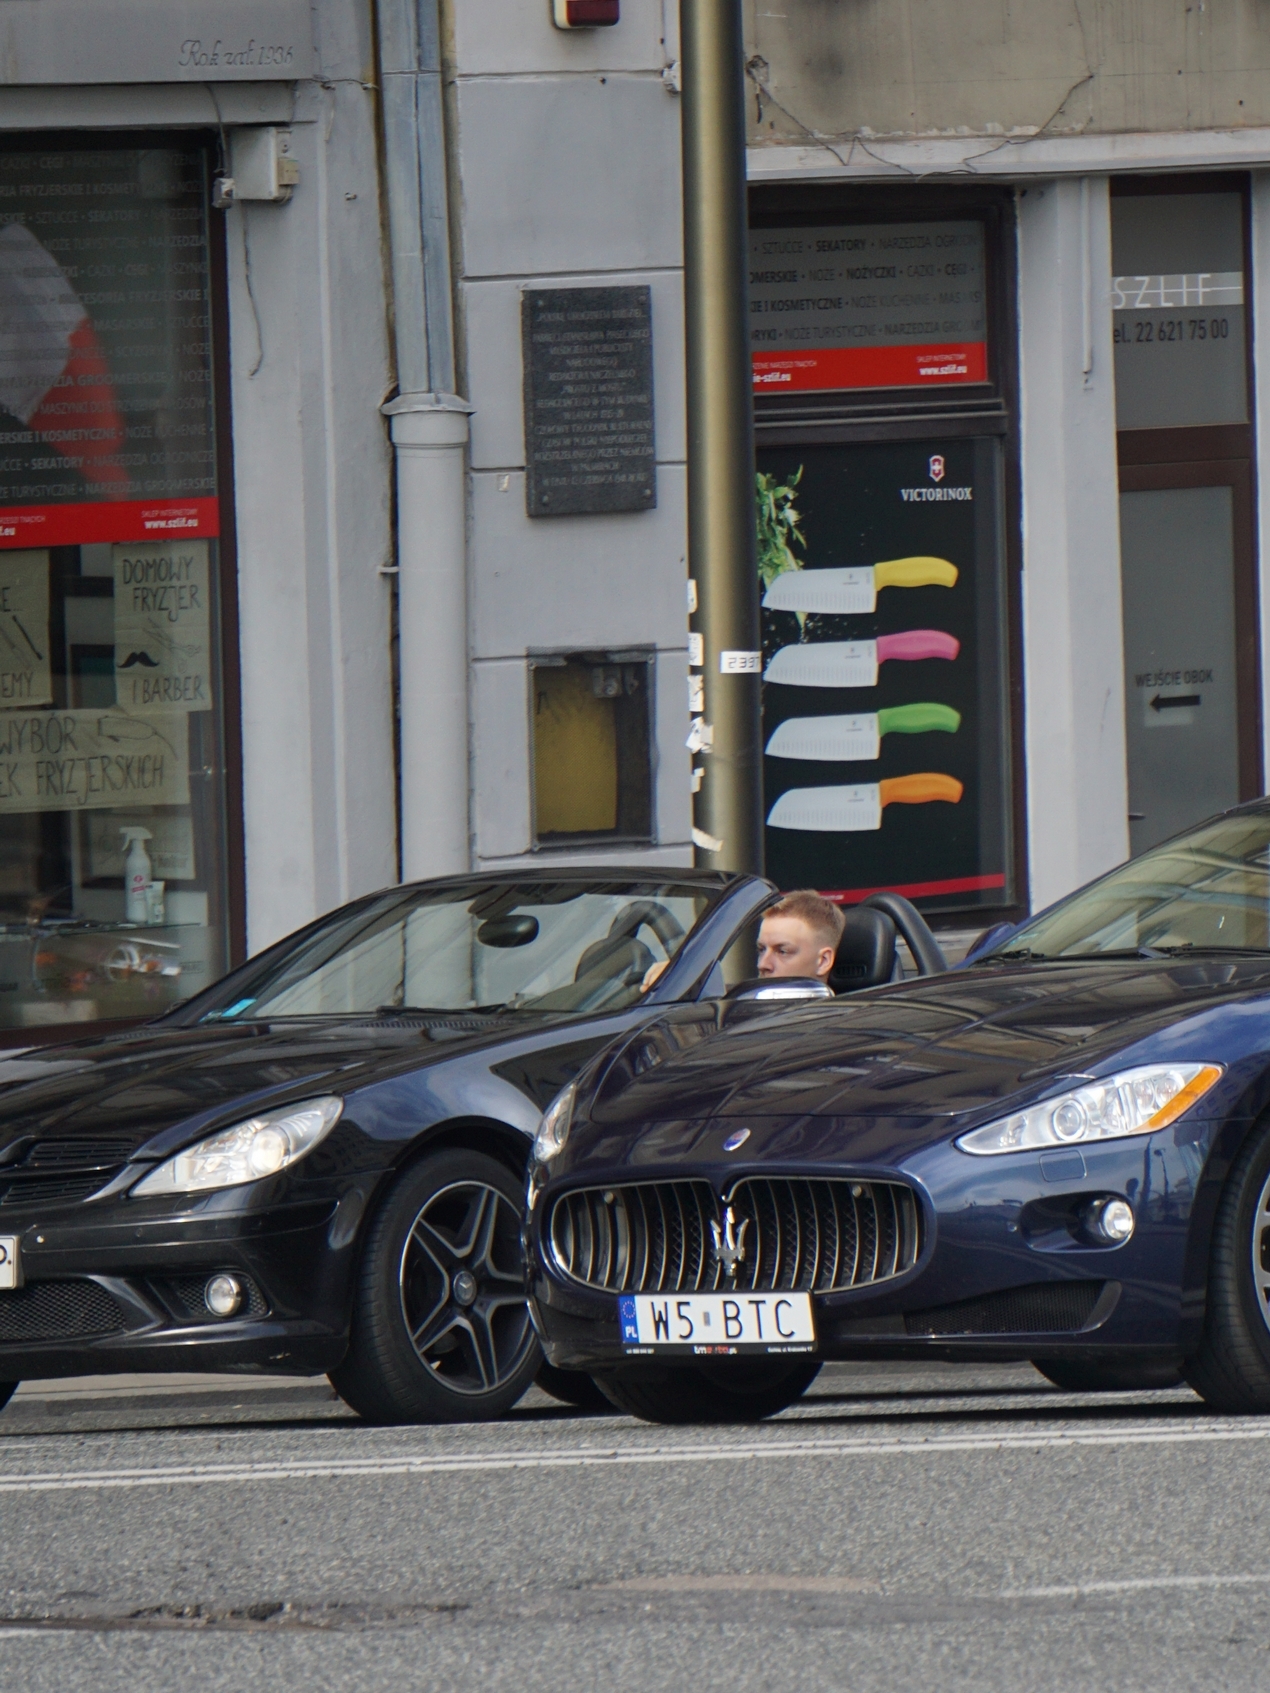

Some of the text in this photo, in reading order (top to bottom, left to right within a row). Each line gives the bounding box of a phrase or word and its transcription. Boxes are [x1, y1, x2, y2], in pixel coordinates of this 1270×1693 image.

[178, 39, 222, 67] Rok
[257, 45, 294, 65] 1936
[815, 237, 868, 252] SEKATORY
[749, 269, 798, 284] OMERSKIE
[845, 264, 897, 281] NOŻYCZKI
[1113, 273, 1212, 309] SZLIF
[771, 296, 844, 312] KOSMETYCZNE
[1113, 317, 1229, 344] el. 22 621 75 00
[919, 364, 968, 377] www.szlif.eu
[0, 431, 34, 445] ERSKIE
[42, 427, 118, 443] KOSMETYCZNE
[31, 455, 86, 470] SEKATORY
[12, 482, 78, 498] TURYSTYCZNE
[900, 486, 974, 503] VICTORINOX
[144, 516, 199, 530] www.szlif.eu
[122, 556, 194, 584] DOMOWY
[132, 584, 202, 622] FRYZJER
[1183, 668, 1214, 685] OBOK
[141, 675, 206, 704] BARBER
[35, 753, 165, 806] FRYZJERSKICH
[651, 1299, 797, 1341] W5 BTC
[626, 1326, 638, 1339] PL
